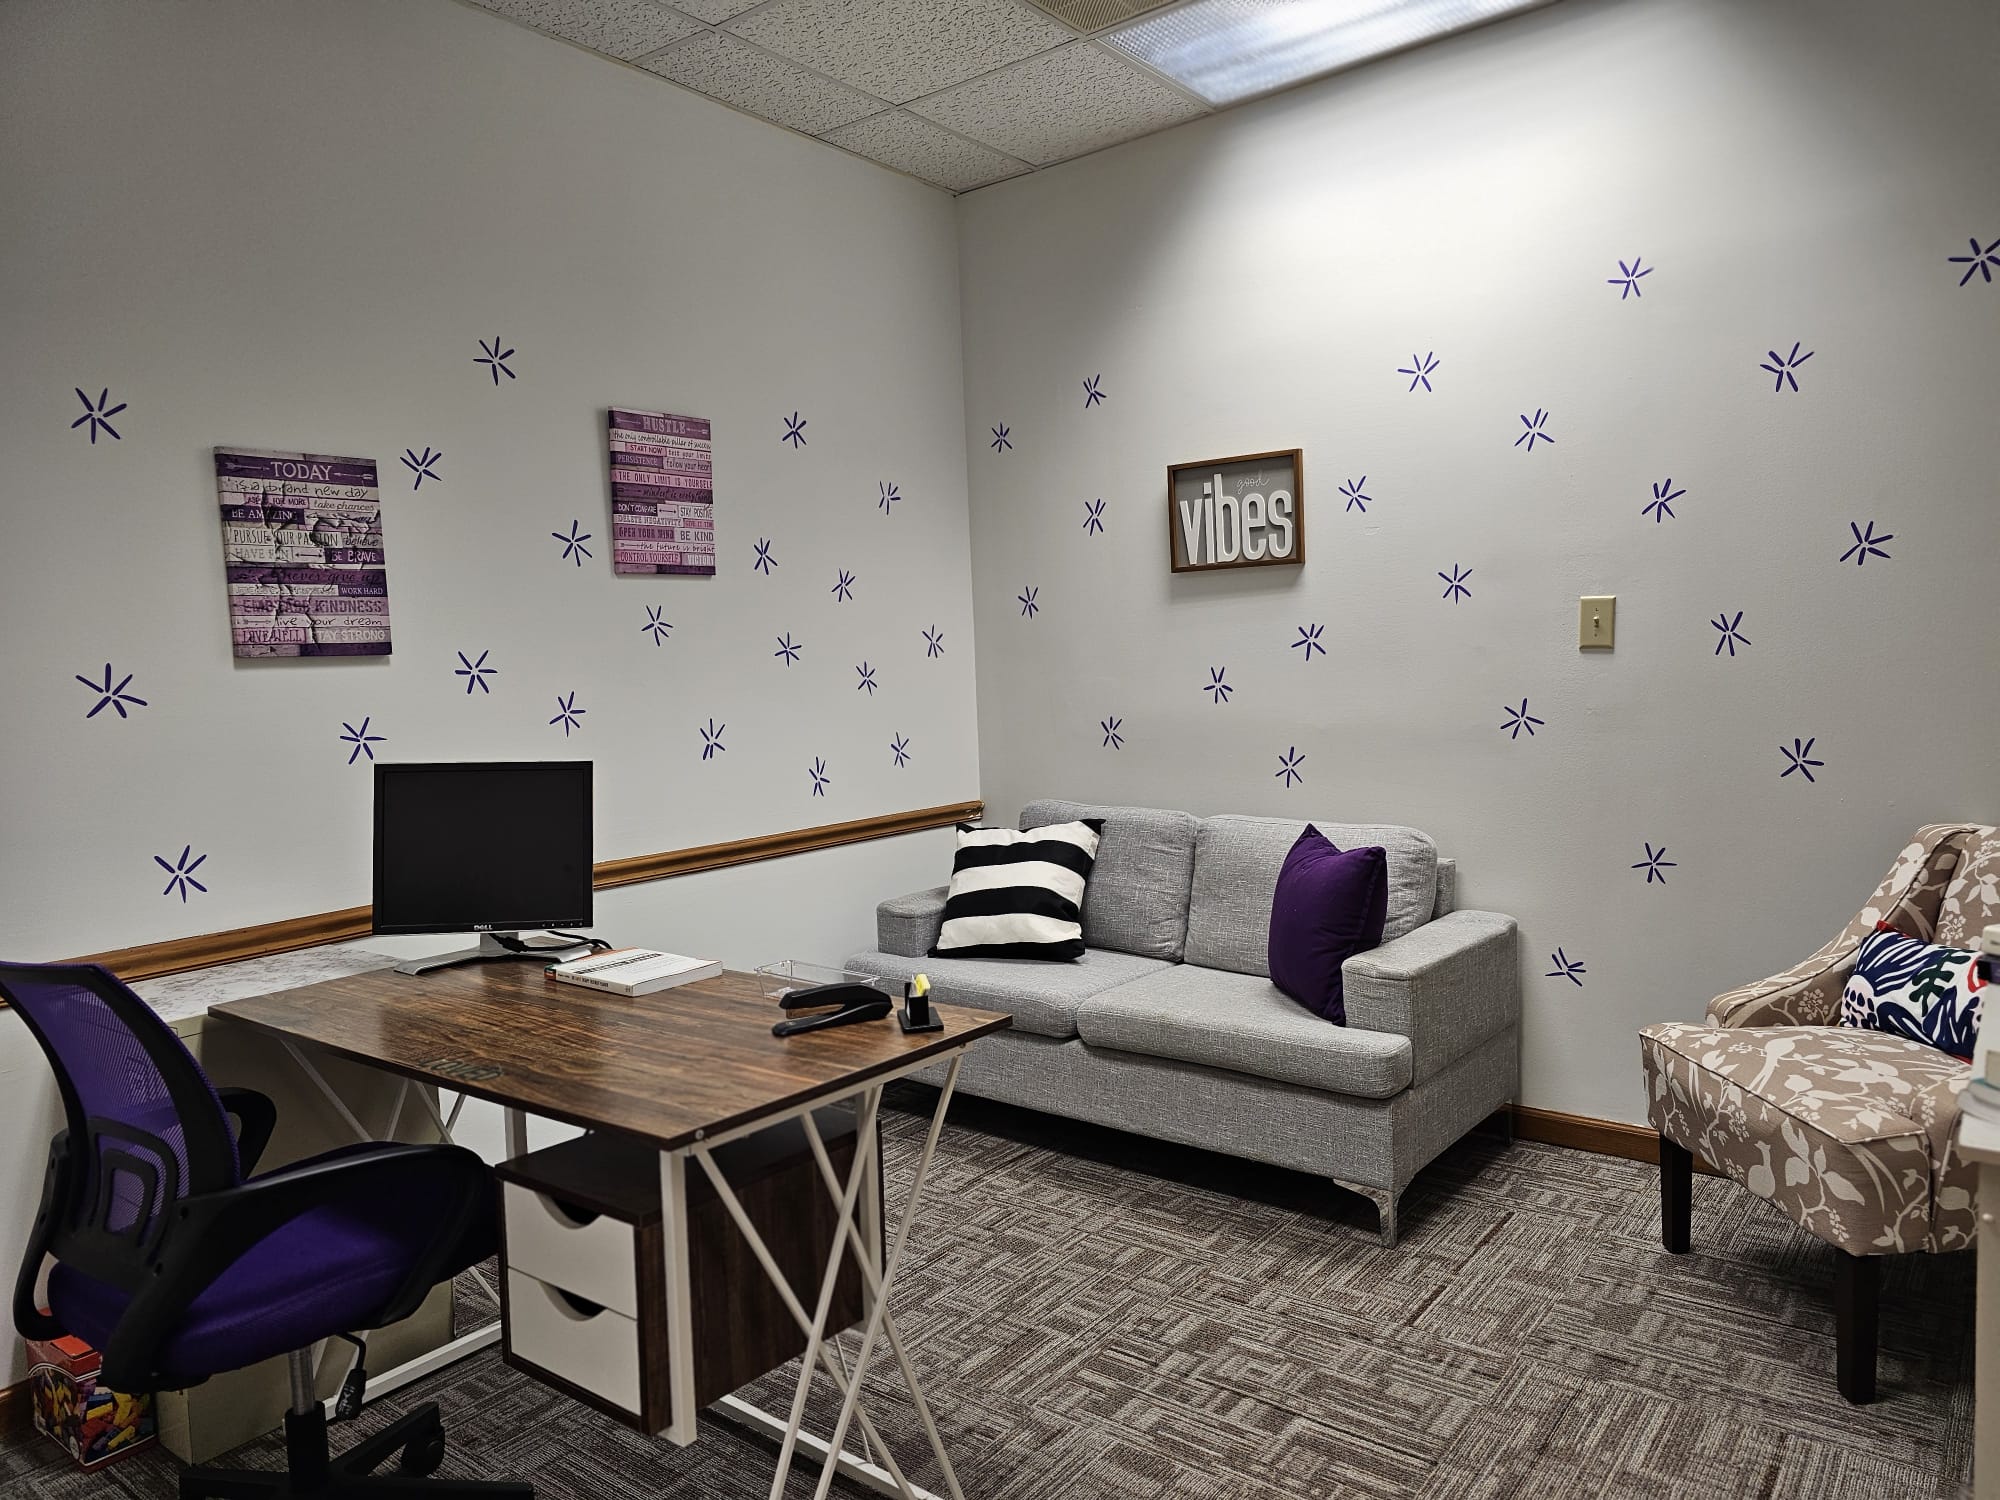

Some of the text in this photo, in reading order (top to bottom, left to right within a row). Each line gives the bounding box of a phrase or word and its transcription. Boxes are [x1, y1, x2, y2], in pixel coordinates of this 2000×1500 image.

[643, 416, 686, 434] HUSTLE
[614, 430, 624, 439] the
[638, 433, 671, 445] controllable
[672, 439, 686, 448] pillar
[687, 440, 694, 449] of
[630, 444, 663, 455] START NOW
[617, 455, 658, 466] PERSISTENCE
[666, 459, 683, 469] follow
[684, 462, 697, 471] your
[270, 461, 334, 481] TODAY
[618, 471, 712, 489] THE ONLY LIMIT IS YOURSELF
[1236, 470, 1271, 495] good
[266, 482, 309, 494] brand
[315, 486, 340, 498] new
[345, 486, 369, 499] day
[272, 497, 286, 506] FOR
[289, 498, 307, 506] MORE
[313, 500, 375, 512] take chances
[618, 501, 657, 514] DON'T COMPARE
[231, 509, 246, 519] BE
[680, 507, 692, 517] STAY
[617, 514, 682, 527] DELETE NEGATIVITY
[1179, 473, 1293, 565] vibes
[233, 529, 268, 545] PURSUE
[297, 531, 339, 548] PAION
[618, 527, 674, 540] OPEN YOUR MIND
[680, 531, 714, 542] BE KIND
[640, 541, 654, 550] the
[656, 542, 680, 552] future
[682, 544, 690, 552] is
[236, 547, 265, 560] HAVE
[331, 549, 378, 563] BE BRAVE
[620, 551, 679, 563] CONTROL YOURSELF
[687, 554, 715, 567] VICTORY
[341, 586, 364, 596] WORK
[364, 587, 383, 596] HARD
[315, 600, 384, 613] KINDNESS
[276, 616, 298, 627] live
[343, 616, 383, 627] dream
[317, 629, 386, 642] TAY STRONG
